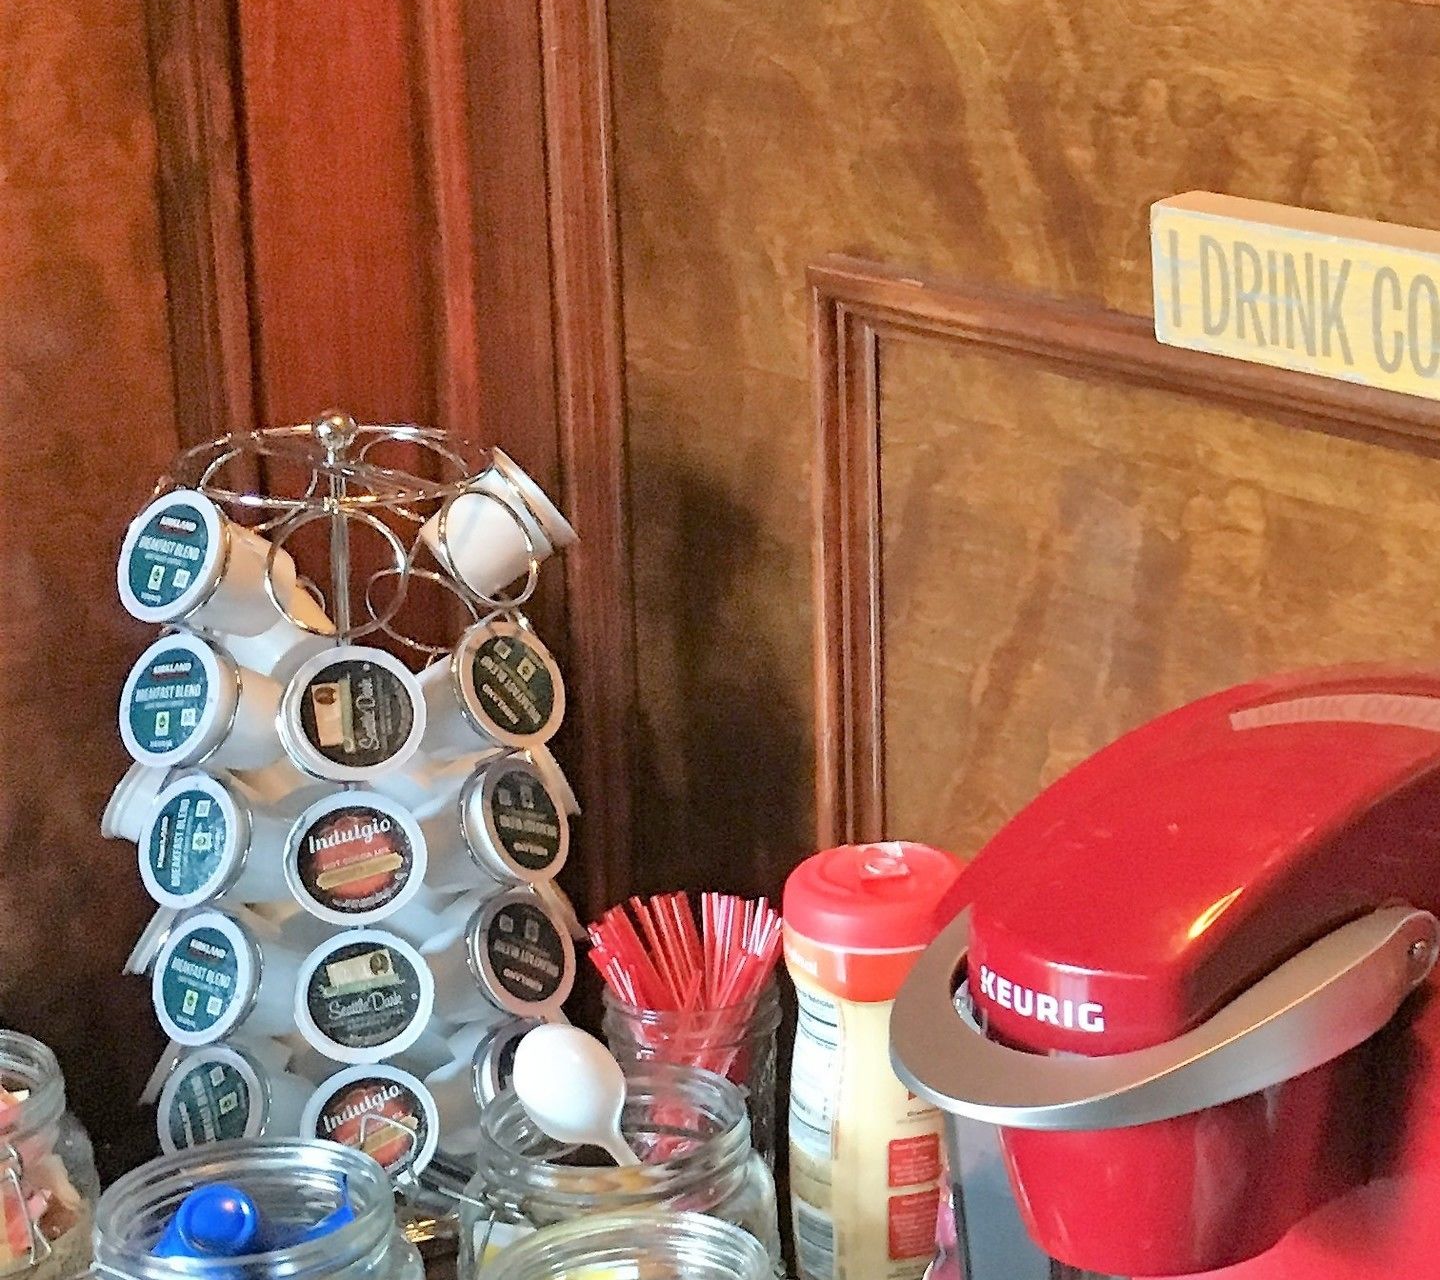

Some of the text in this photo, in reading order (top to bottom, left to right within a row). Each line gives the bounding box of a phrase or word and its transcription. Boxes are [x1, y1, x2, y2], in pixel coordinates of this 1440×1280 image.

[1168, 228, 1183, 329] I
[1199, 234, 1354, 366] DRINK
[173, 543, 201, 561] BLEND
[135, 683, 202, 703] BREAKFAST BLEND
[176, 798, 191, 830] BLEND
[308, 818, 391, 855] Indulgio
[170, 831, 184, 888] BREAKFAST
[205, 969, 232, 989] BLEND
[366, 991, 402, 1012] Dark
[979, 964, 1105, 1033] KEURIG
[323, 1084, 399, 1133] Indulgio
